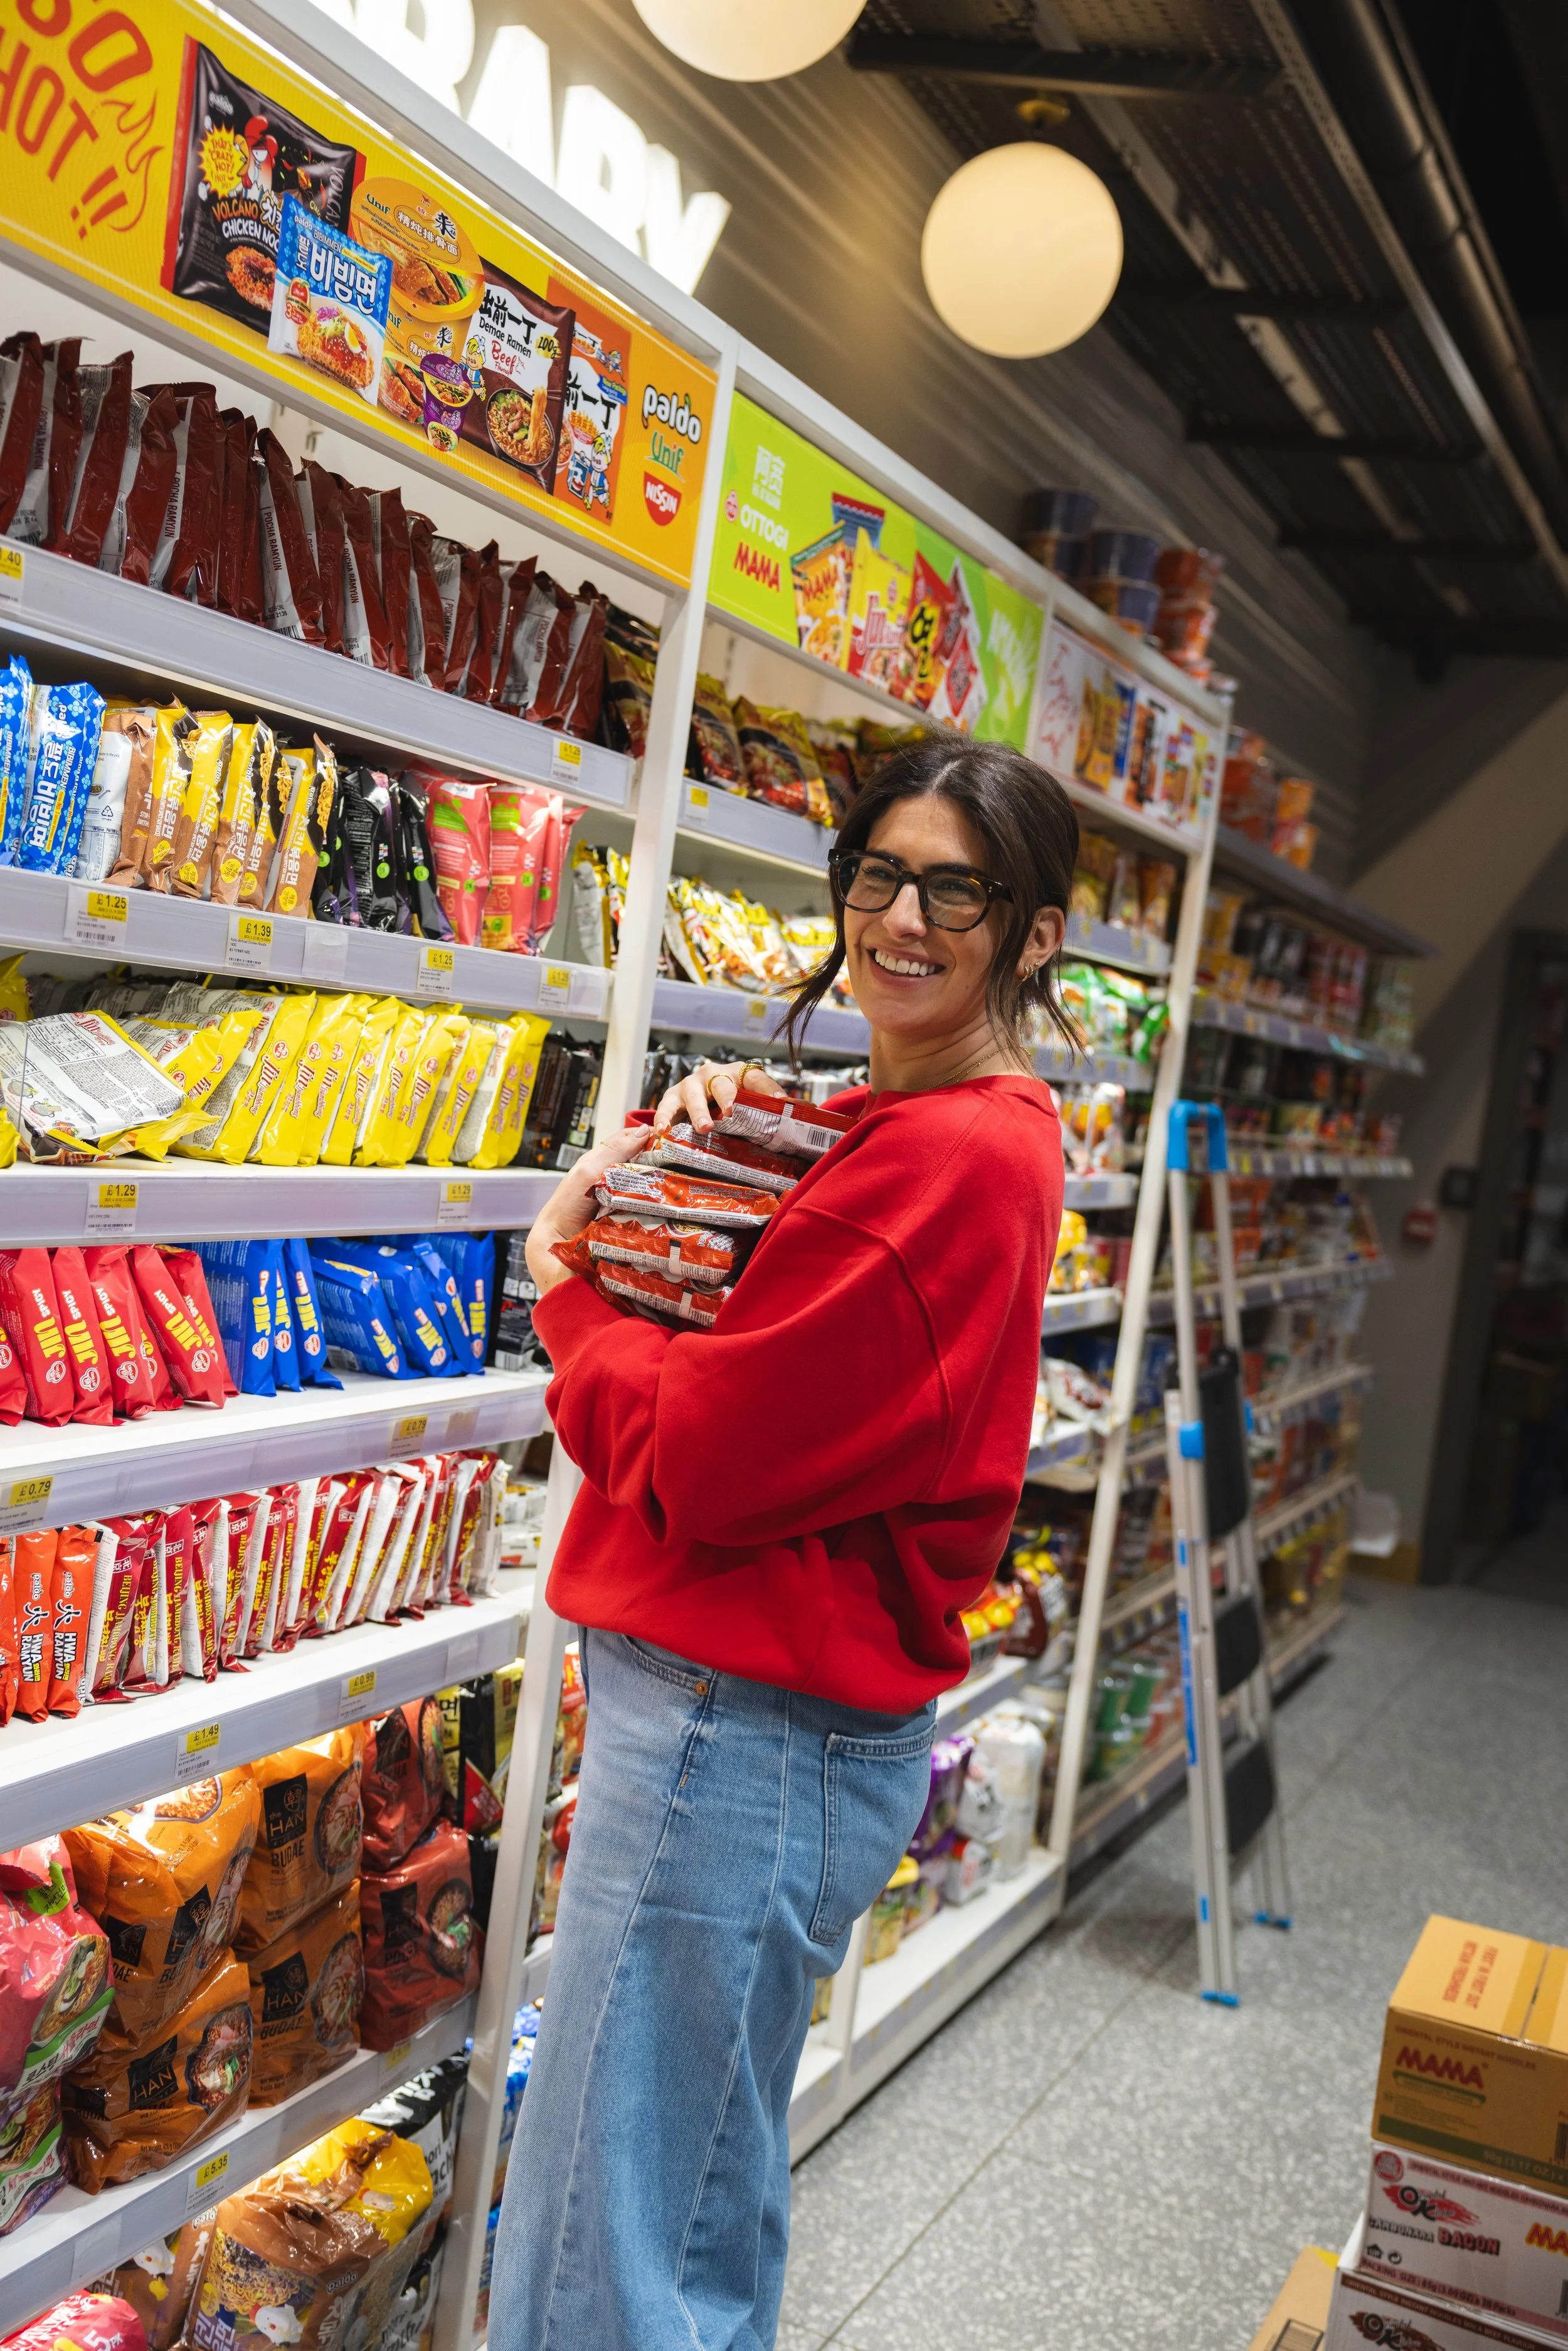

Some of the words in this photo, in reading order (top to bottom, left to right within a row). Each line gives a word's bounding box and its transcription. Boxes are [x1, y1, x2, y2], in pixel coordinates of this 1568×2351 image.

[212, 199, 258, 223] VOLCANO
[366, 193, 391, 215] Unif
[222, 218, 262, 241] CHICKEN
[314, 229, 341, 253] BIBIMMEN
[310, 241, 377, 316] 비빔면
[388, 310, 401, 330] nif
[479, 316, 506, 341] Demae
[506, 333, 531, 358] Ramen
[537, 336, 559, 359] 100g
[491, 339, 517, 375] Beef
[36, 409, 49, 437] POCHA
[642, 385, 701, 443] paldo
[33, 437, 46, 470] RAMYUN
[650, 432, 684, 474] Unif
[167, 477, 181, 504] POCHA
[645, 481, 678, 514] NISSIN
[164, 503, 178, 538] RAMYUN
[263, 511, 276, 539] POCHA
[740, 504, 790, 551] OTTOGI
[268, 538, 283, 571] RAMYUN
[733, 541, 781, 593] MAMA
[347, 573, 360, 604] RAMYUN
[3, 730, 14, 774] BIBIMMEN
[42, 742, 64, 780] 팔도
[60, 745, 77, 790] BIBIMMEN
[245, 755, 255, 780] paldo
[305, 785, 315, 812] paldo
[24, 780, 58, 849] 비빔면
[191, 786, 220, 862] 치킨볶음면
[231, 784, 256, 861] 치킨볶음면
[286, 815, 309, 886] 치킨볶음면
[105, 895, 127, 909] 1.25
[253, 923, 272, 938] 1.39
[438, 954, 453, 965] 1.25
[256, 1054, 282, 1088] Jin
[297, 1058, 316, 1090] Jin
[115, 1184, 135, 1196] 1.29
[457, 1184, 471, 1197] 1.29
[32, 1288, 51, 1318] SPICY
[62, 1290, 82, 1320] SPICY
[96, 1288, 116, 1317] SPICY
[154, 1289, 177, 1315] SPICY
[412, 1419, 427, 1431] 0.79
[28, 1480, 51, 1495] 0.79
[230, 1517, 248, 1534] 北京
[285, 1522, 294, 1558] BEIJING
[238, 1534, 247, 1570] BEIJING
[269, 1527, 279, 1563] BEIJING
[30, 1573, 43, 1601] paldo
[62, 1571, 74, 1599] paldo
[174, 1556, 183, 1596] BEIJING
[115, 1574, 132, 1610] BEIJING
[203, 1581, 213, 1629] JJAMBBONG
[172, 1595, 182, 1645] JJAMBBONG
[30, 1632, 45, 1662] HWA
[63, 1632, 77, 1662] HWA
[107, 1611, 126, 1662] JJAMBBONG
[21, 1635, 34, 1682] RAMYUN
[53, 1632, 65, 1680] RAMYUN
[359, 1672, 374, 1685] 0.99
[201, 1724, 220, 1739] 1.49
[270, 1810, 305, 1837] HAN
[271, 1837, 305, 1867] BUDAE
[267, 1990, 305, 2011] HAN
[260, 2015, 305, 2039] BUDAE
[24, 2054, 60, 2083] 로스팅
[61, 2017, 100, 2058] 서울라면
[1395, 2046, 1485, 2091] MAMA
[133, 2066, 172, 2102] HAN
[211, 2156, 228, 2174] 5.35
[1368, 2216, 1435, 2243] CARBONARA
[1437, 2225, 1502, 2257] BACON
[1525, 2221, 1568, 2258] MA
[327, 2271, 359, 2294] paldo
[1360, 2261, 1396, 2279] PACKING
